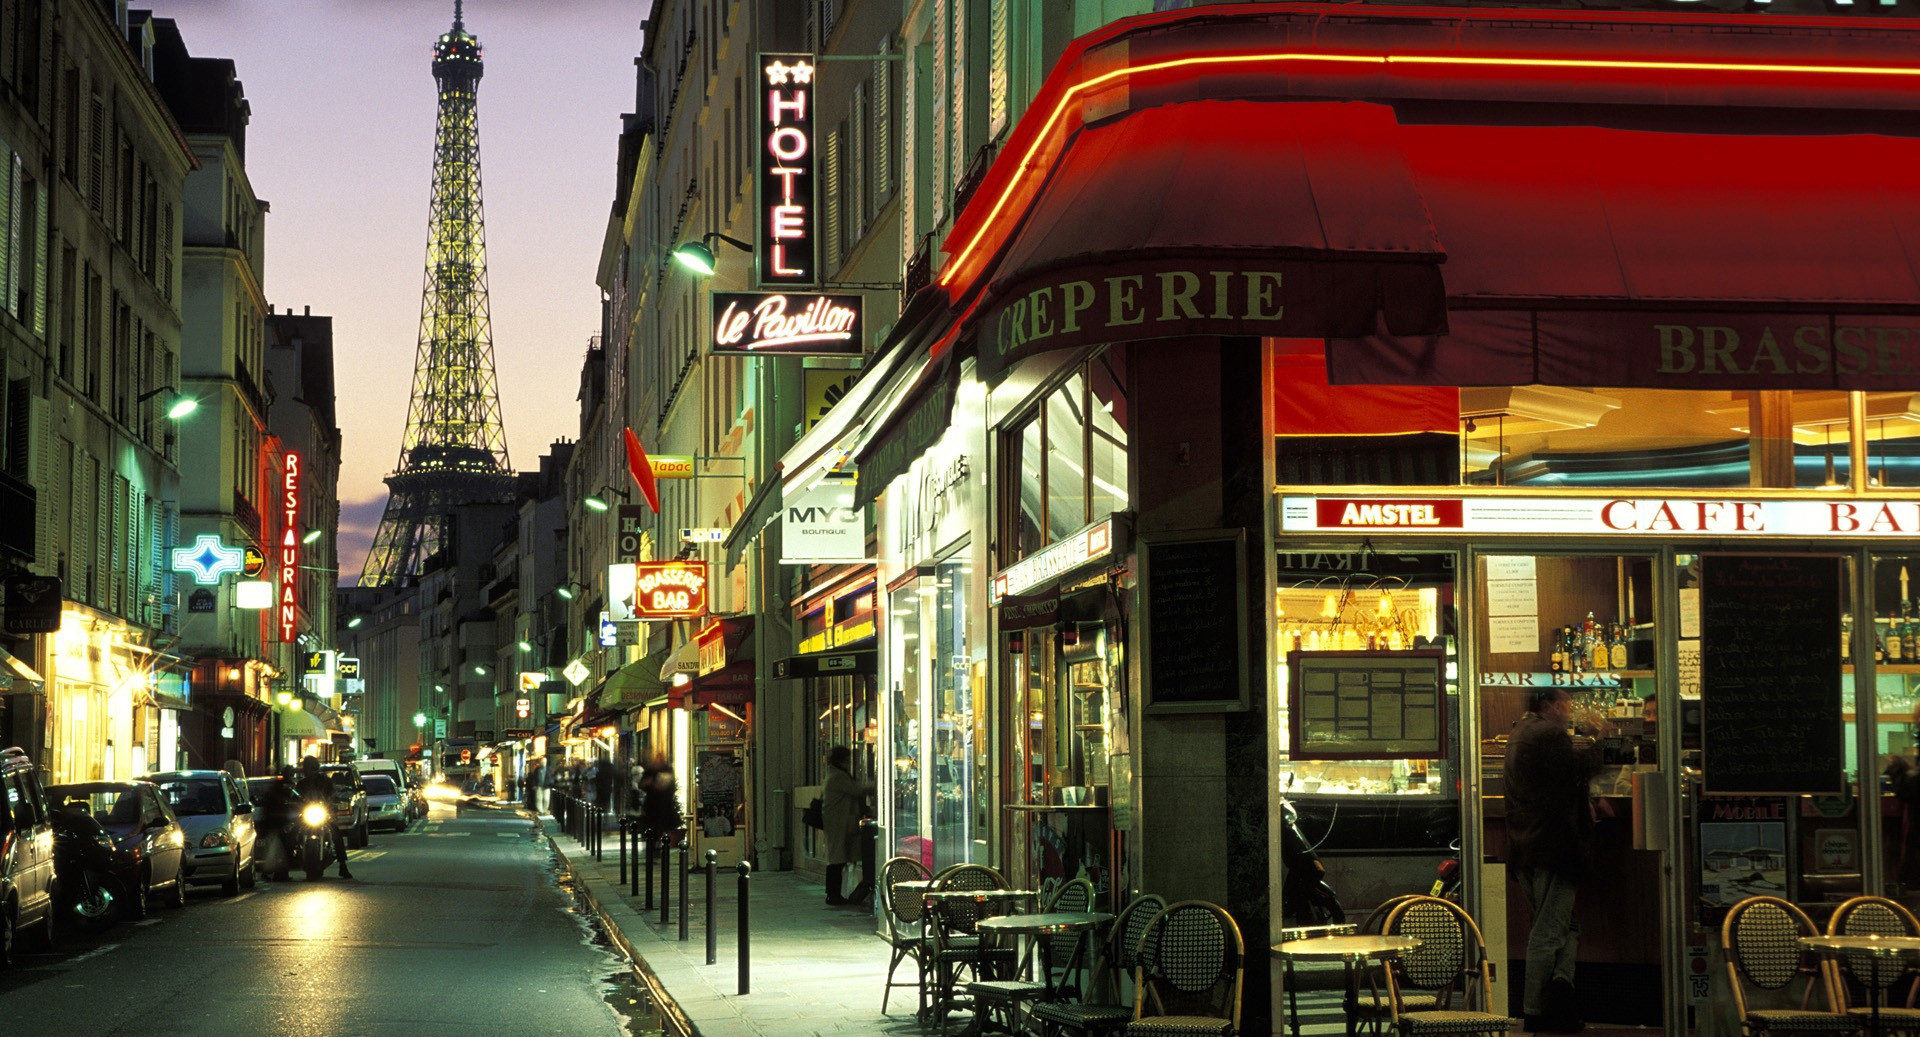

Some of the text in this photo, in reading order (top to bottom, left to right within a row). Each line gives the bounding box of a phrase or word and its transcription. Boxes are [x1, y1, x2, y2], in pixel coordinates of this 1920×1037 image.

[769, 88, 808, 277] HOTEL
[753, 294, 857, 340] Pavillon
[997, 269, 1285, 356] CREPERIE
[1654, 324, 1920, 377] BRASSE
[653, 460, 691, 472] Tabac
[1340, 503, 1441, 525] AMSTEL
[1600, 499, 1920, 533] CAFE BA
[284, 453, 298, 641] RESTAURANT
[638, 568, 705, 594] BRASSERIE
[652, 590, 690, 610] BAR
[339, 664, 358, 674] CCF
[1480, 671, 1622, 686] BAR BRAS
[1712, 801, 1787, 820] MOBILE
